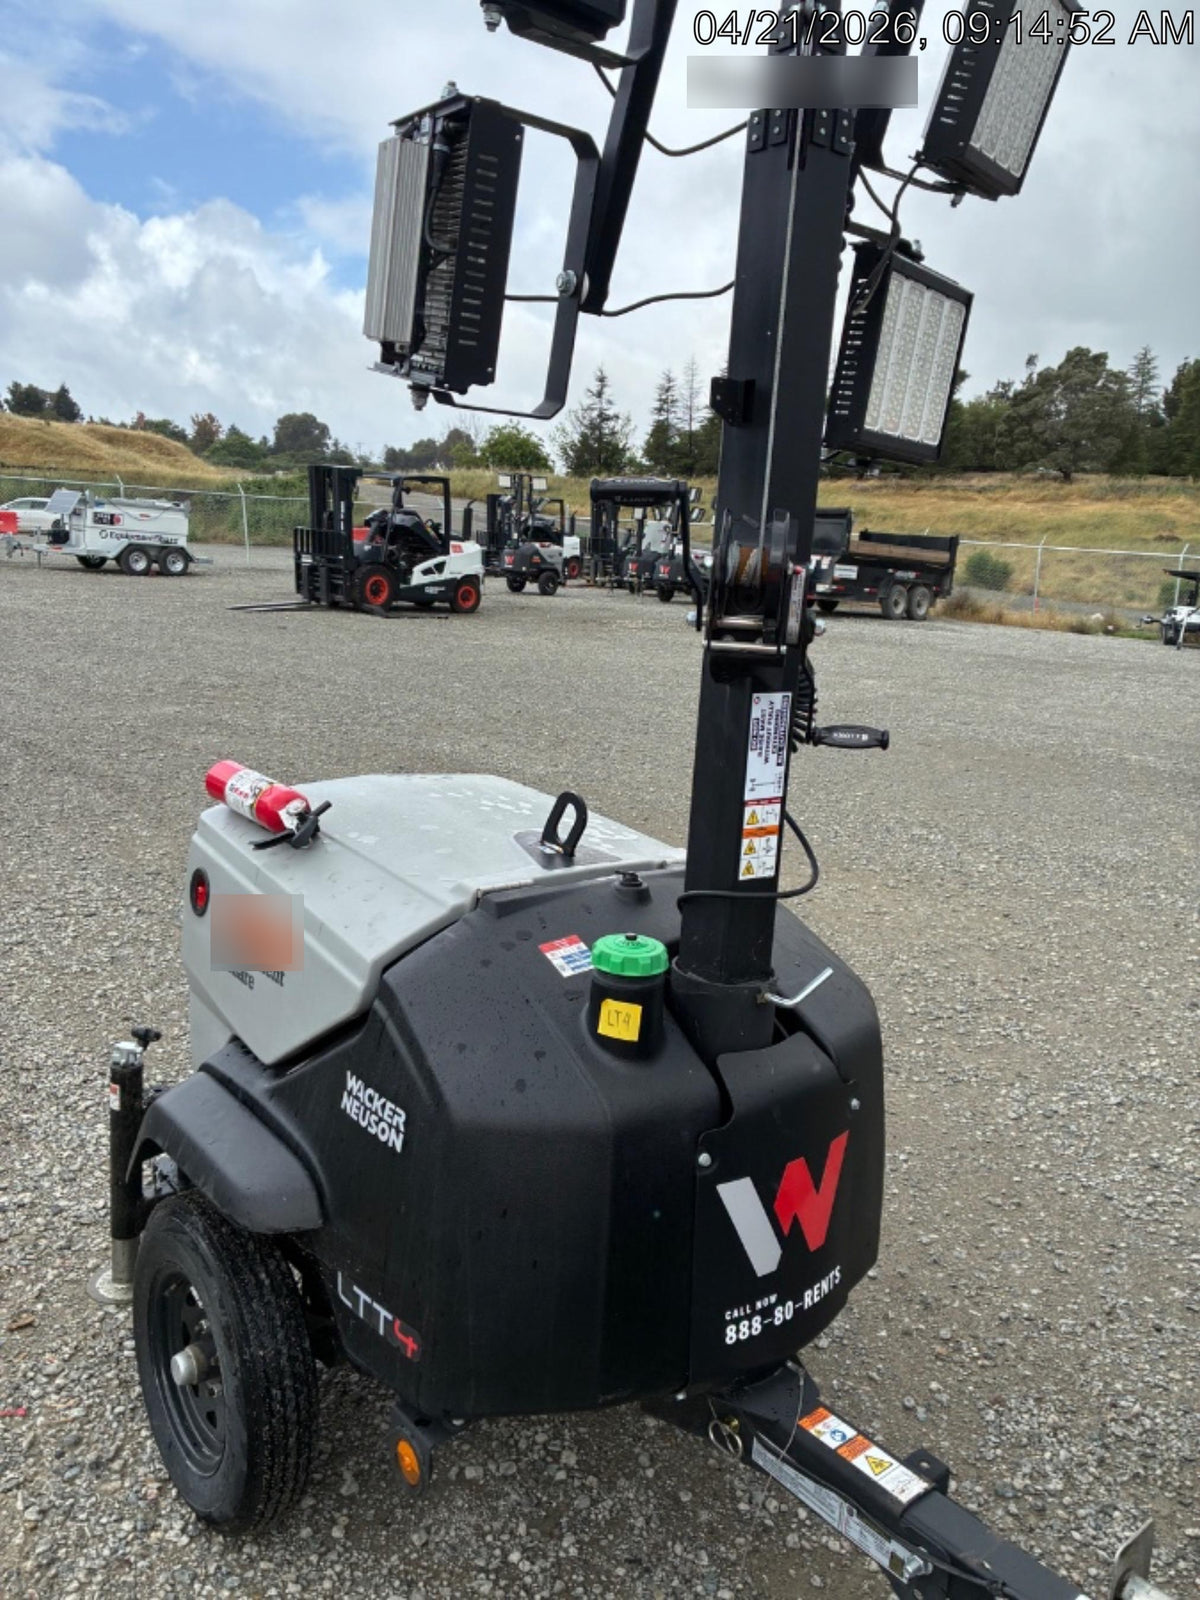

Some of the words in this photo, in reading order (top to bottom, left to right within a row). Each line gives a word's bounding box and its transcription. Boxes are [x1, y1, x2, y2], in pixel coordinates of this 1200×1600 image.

[341, 1091, 404, 1153] NEUSON
[345, 1069, 406, 1133] WACKER
[337, 1270, 418, 1358] LTT4
[725, 1265, 842, 1345] 888-80-RENTS
[725, 1304, 752, 1320] CALL
[755, 1293, 778, 1311] NOW
